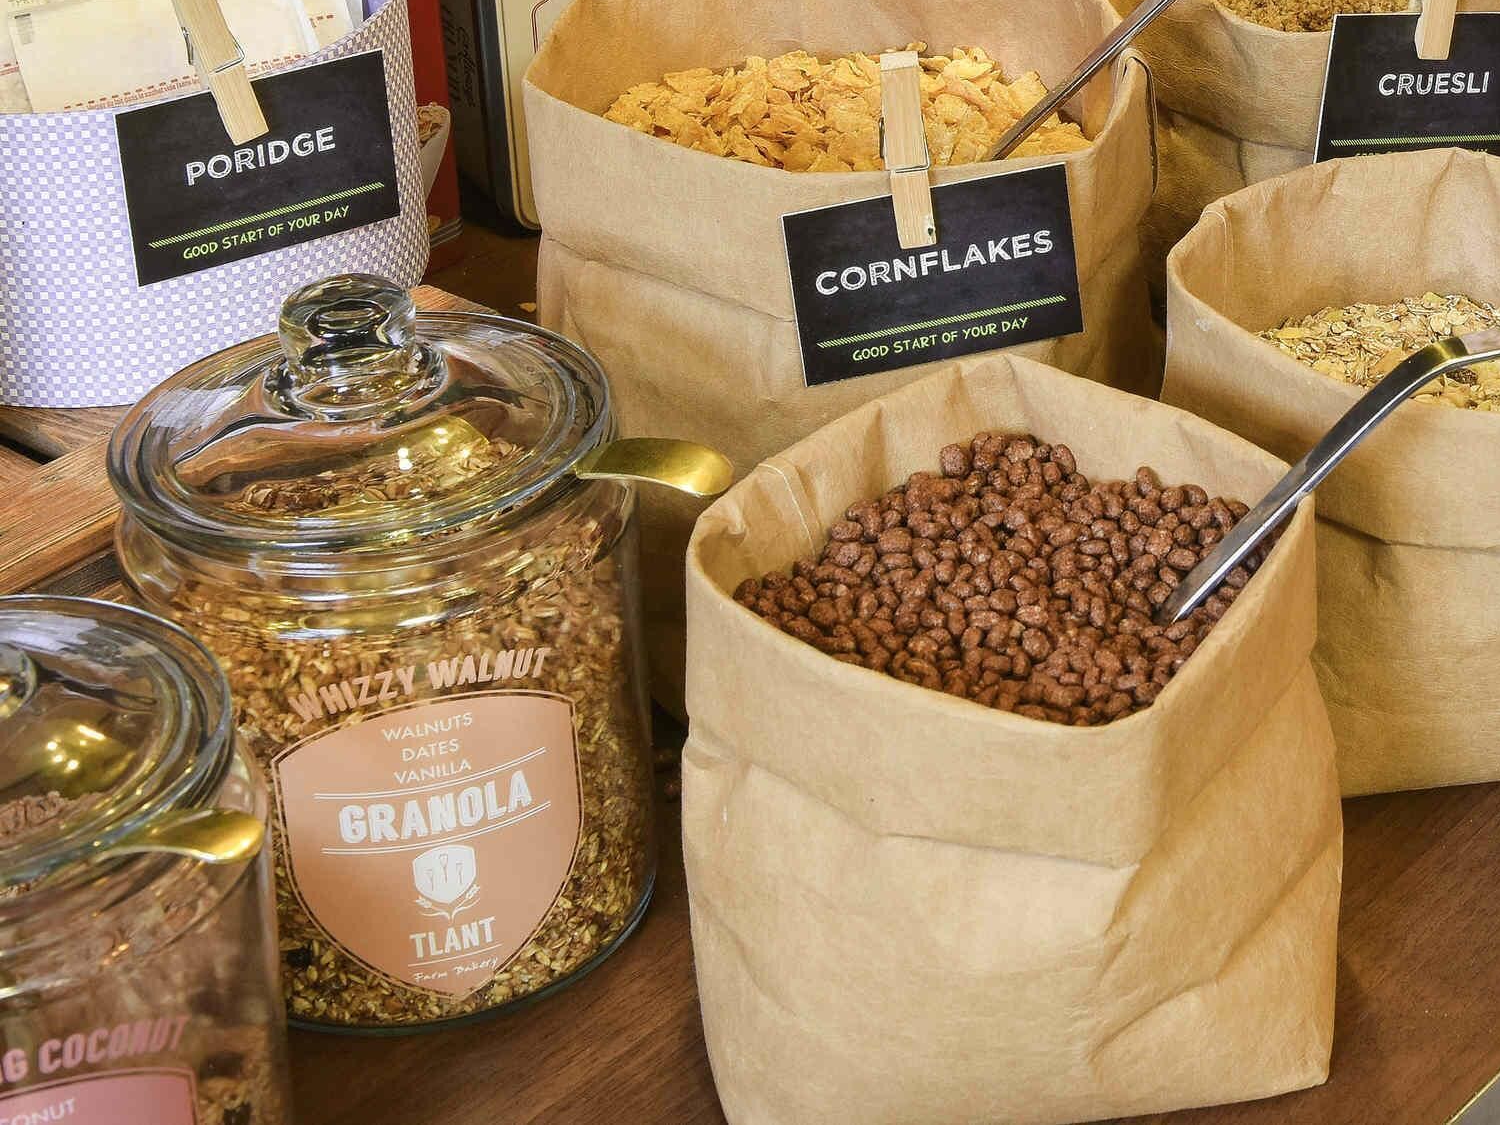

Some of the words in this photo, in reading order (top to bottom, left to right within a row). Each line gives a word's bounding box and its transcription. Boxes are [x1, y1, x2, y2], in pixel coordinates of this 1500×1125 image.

[1378, 71, 1491, 97] CRUESLI
[185, 126, 337, 186] PORIDGE
[183, 240, 218, 260] GOOD
[222, 229, 264, 251] START
[268, 221, 287, 237] OF
[288, 213, 321, 233] YOUR
[324, 204, 351, 225] DAY
[815, 229, 1054, 295] CORNFLAKES
[852, 344, 889, 362] GOOD
[893, 334, 937, 353] START
[941, 330, 958, 343] OF
[962, 323, 998, 340] YOUR
[1001, 316, 1029, 332] DAY
[288, 665, 416, 723] WHIZZY
[427, 647, 552, 689] WALNUT
[381, 711, 474, 742] WALNUTS
[402, 738, 460, 762] DATES
[393, 757, 473, 786] VANILLA
[338, 770, 533, 844] GRANOLA
[409, 915, 496, 959] TLANT
[38, 1014, 191, 1074] COCONUT
